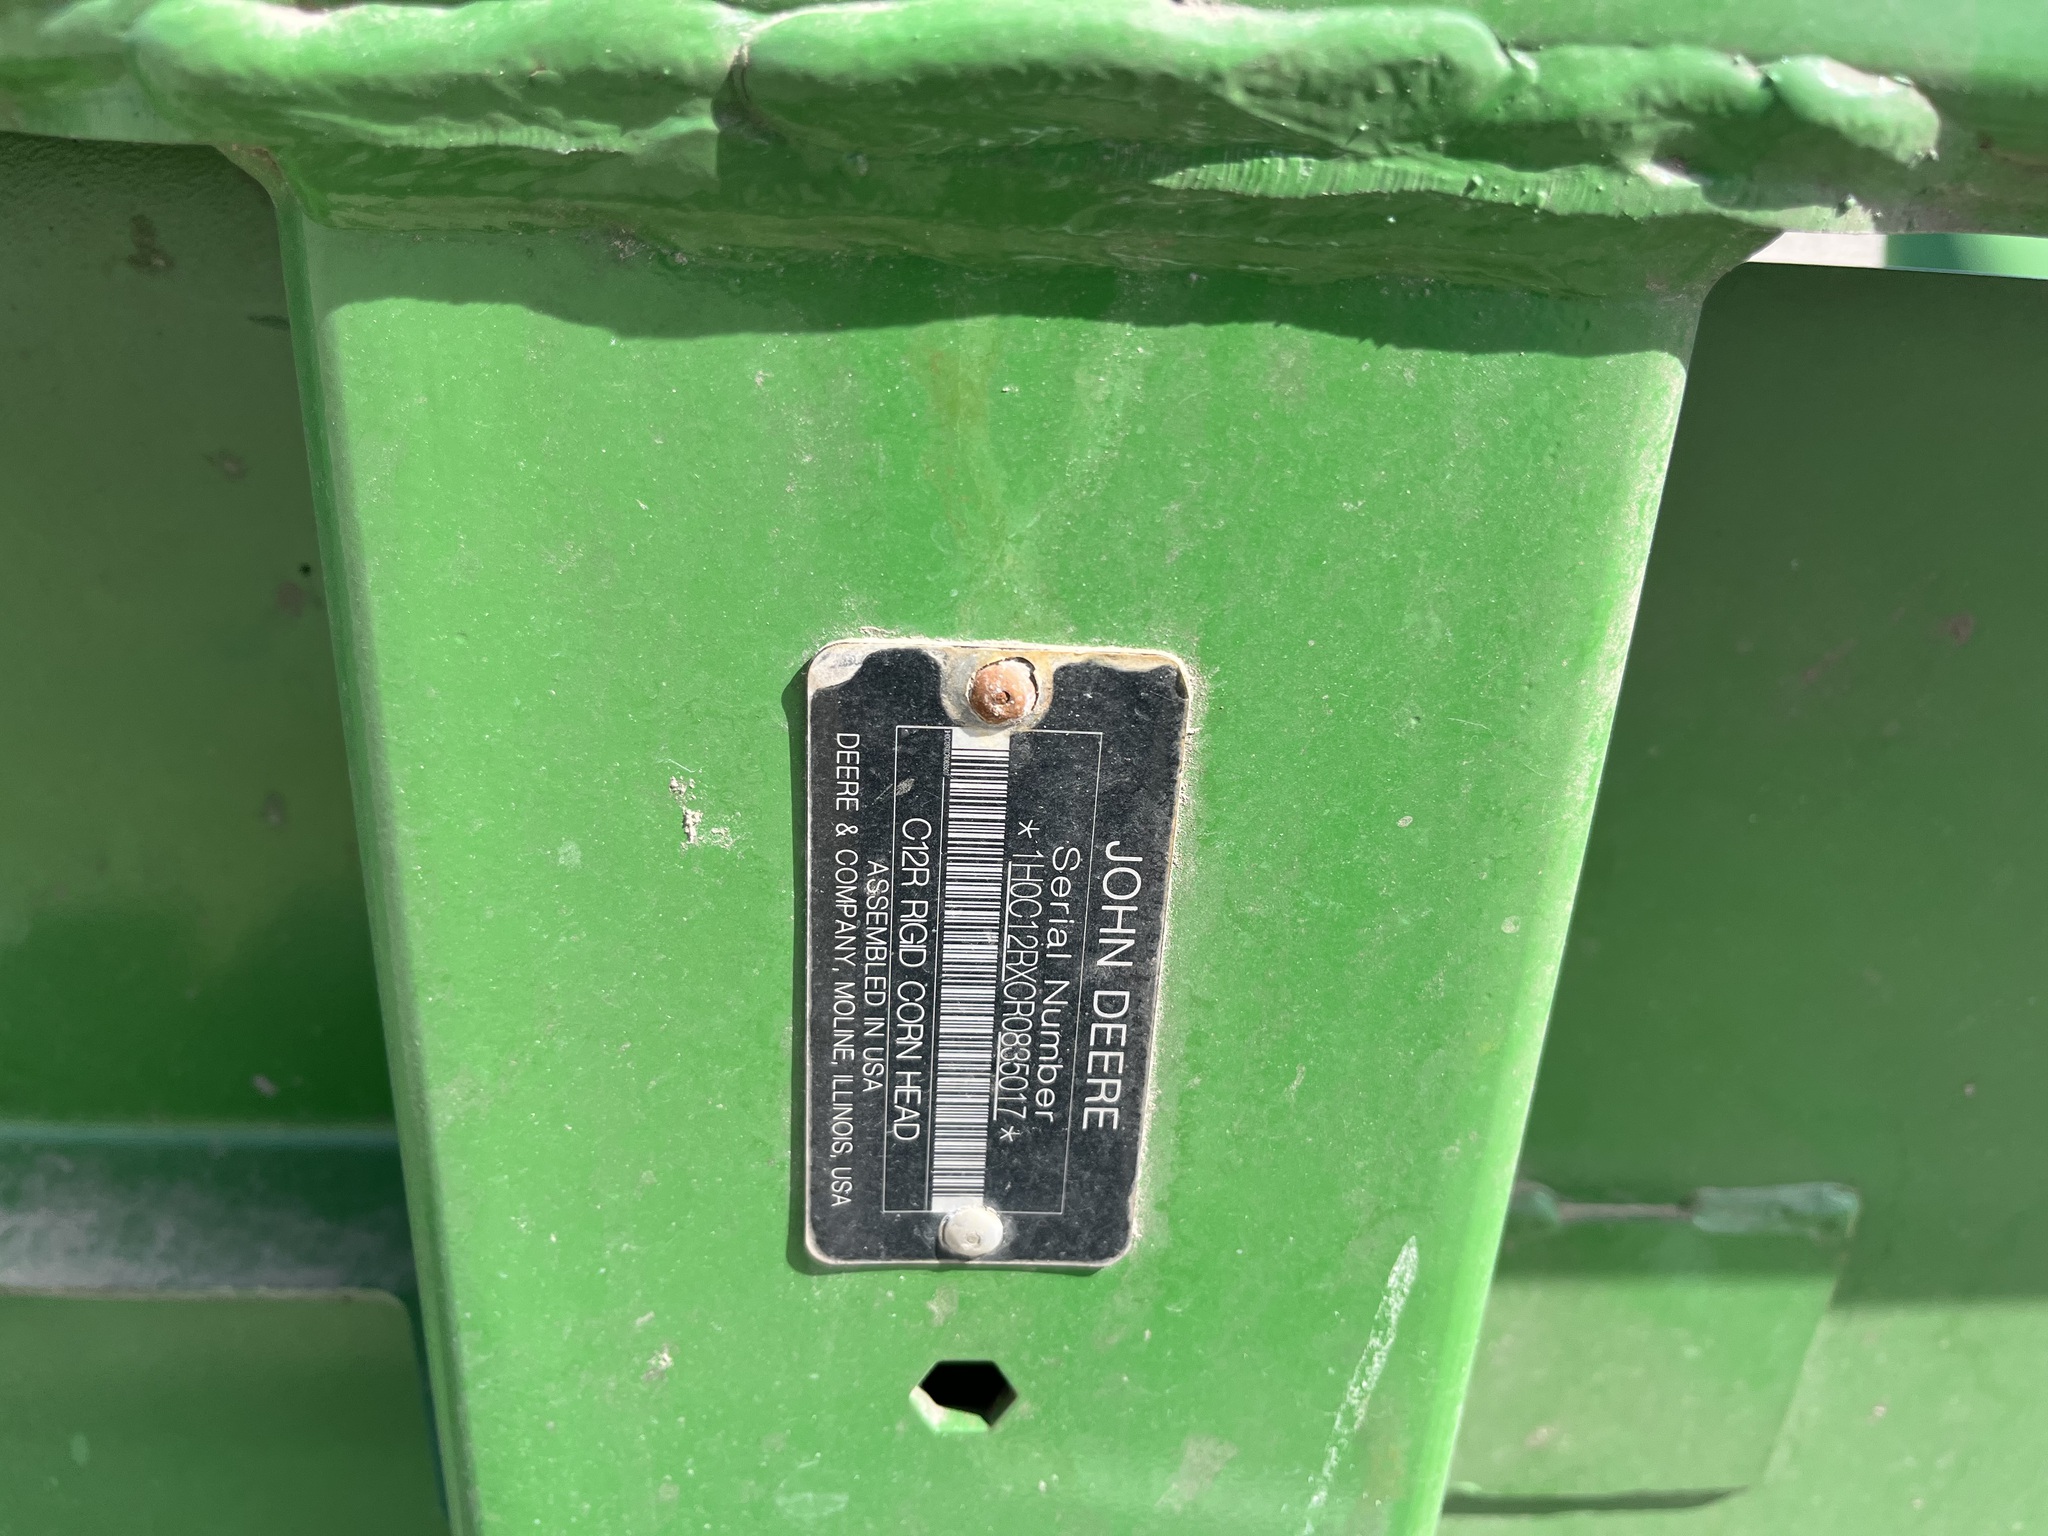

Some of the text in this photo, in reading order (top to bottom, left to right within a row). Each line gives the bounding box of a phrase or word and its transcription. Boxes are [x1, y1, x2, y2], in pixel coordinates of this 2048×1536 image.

[831, 733, 860, 1207] DEERE & COMPANY, MOLINE, ILLINOIS, USA
[862, 860, 890, 1092] ASSEMBLED IN USA
[893, 818, 932, 1141] C12R RIGID CORN HEAD
[1035, 846, 1081, 1122] Serial Number
[1082, 841, 1143, 1129] JOHN DEERE
